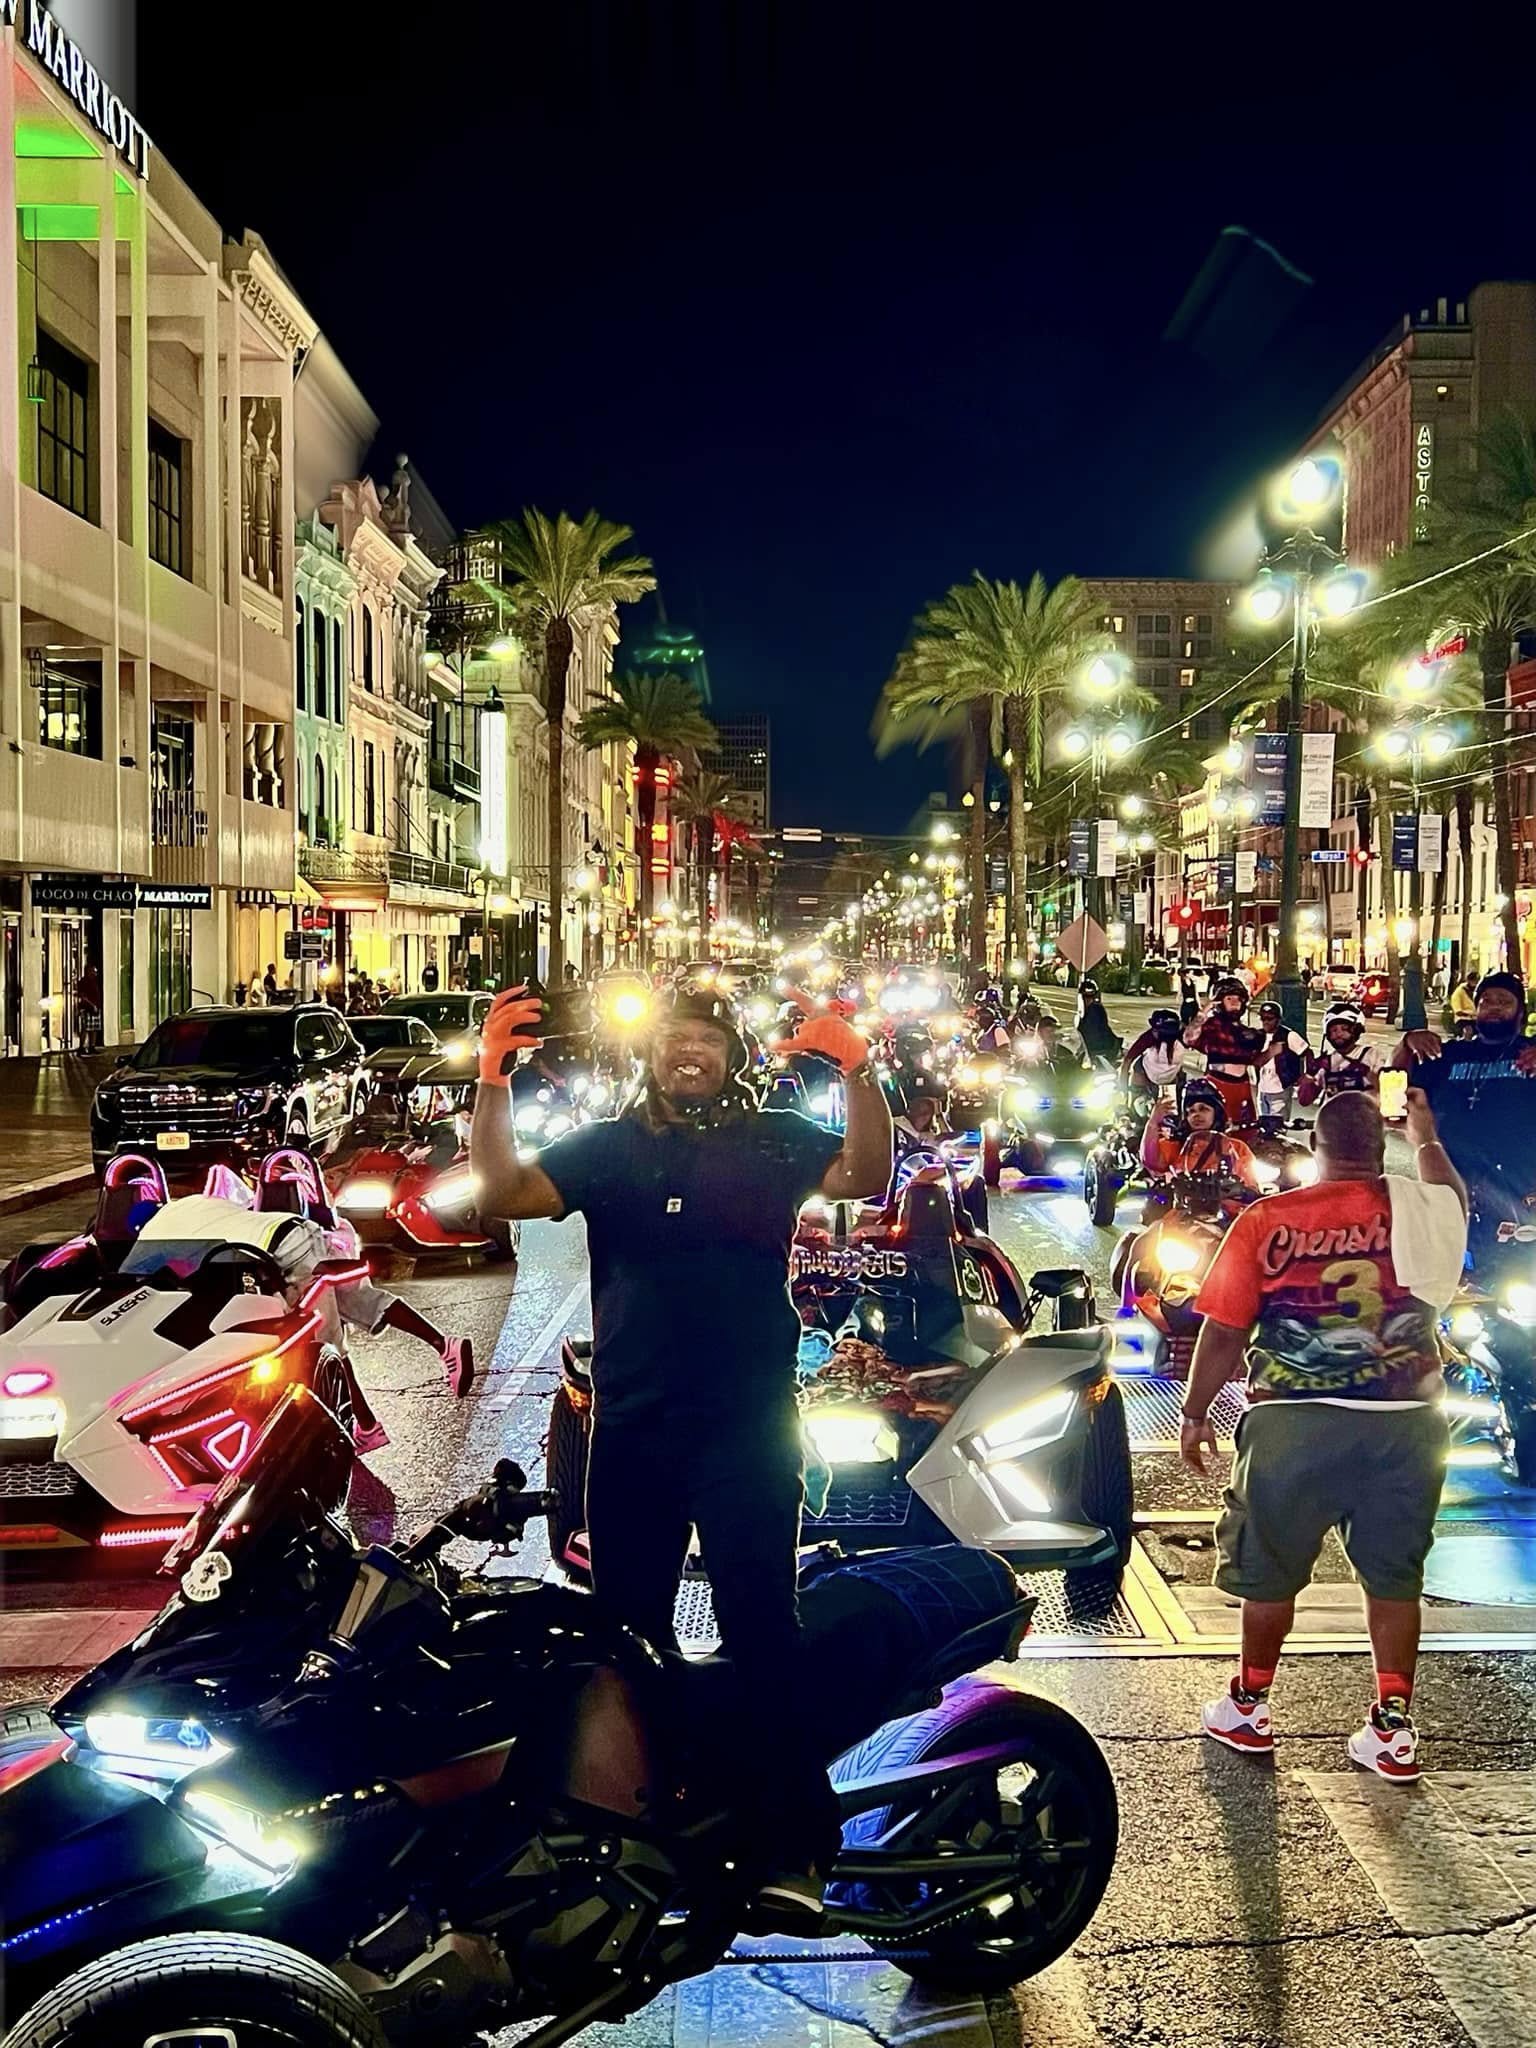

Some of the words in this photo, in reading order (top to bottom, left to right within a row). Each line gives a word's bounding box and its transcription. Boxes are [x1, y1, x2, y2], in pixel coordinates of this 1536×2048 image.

[28, 0, 153, 182] MARRIOTT
[35, 888, 74, 900] FOGO
[143, 891, 209, 903] MARRIOTT
[1258, 1214, 1390, 1276] Crensh
[100, 1289, 151, 1327] SLINGSHOT
[1318, 1259, 1385, 1328] 3
